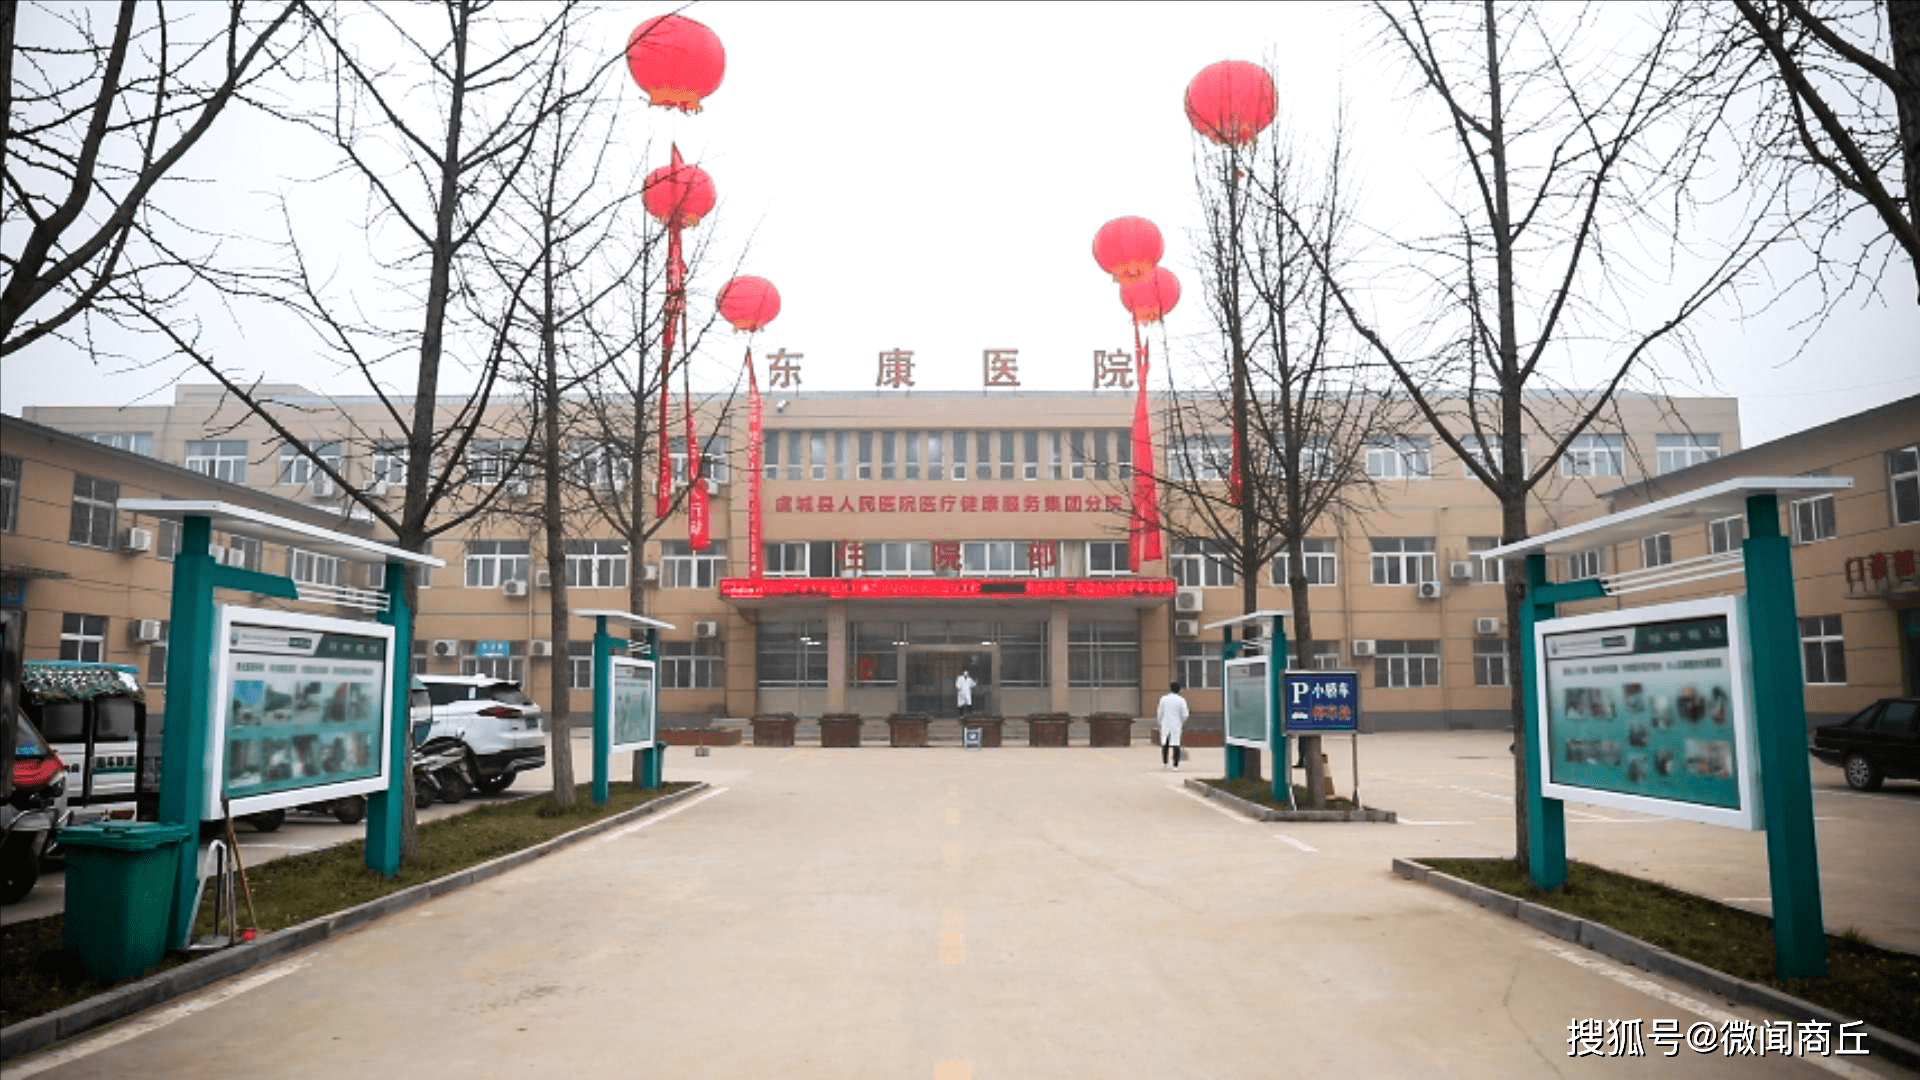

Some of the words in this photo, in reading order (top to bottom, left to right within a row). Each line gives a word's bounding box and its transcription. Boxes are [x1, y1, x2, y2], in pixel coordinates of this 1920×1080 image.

[766, 347, 1135, 389] 东康医院
[837, 540, 1057, 571] 住院部
[1291, 682, 1309, 704] P
